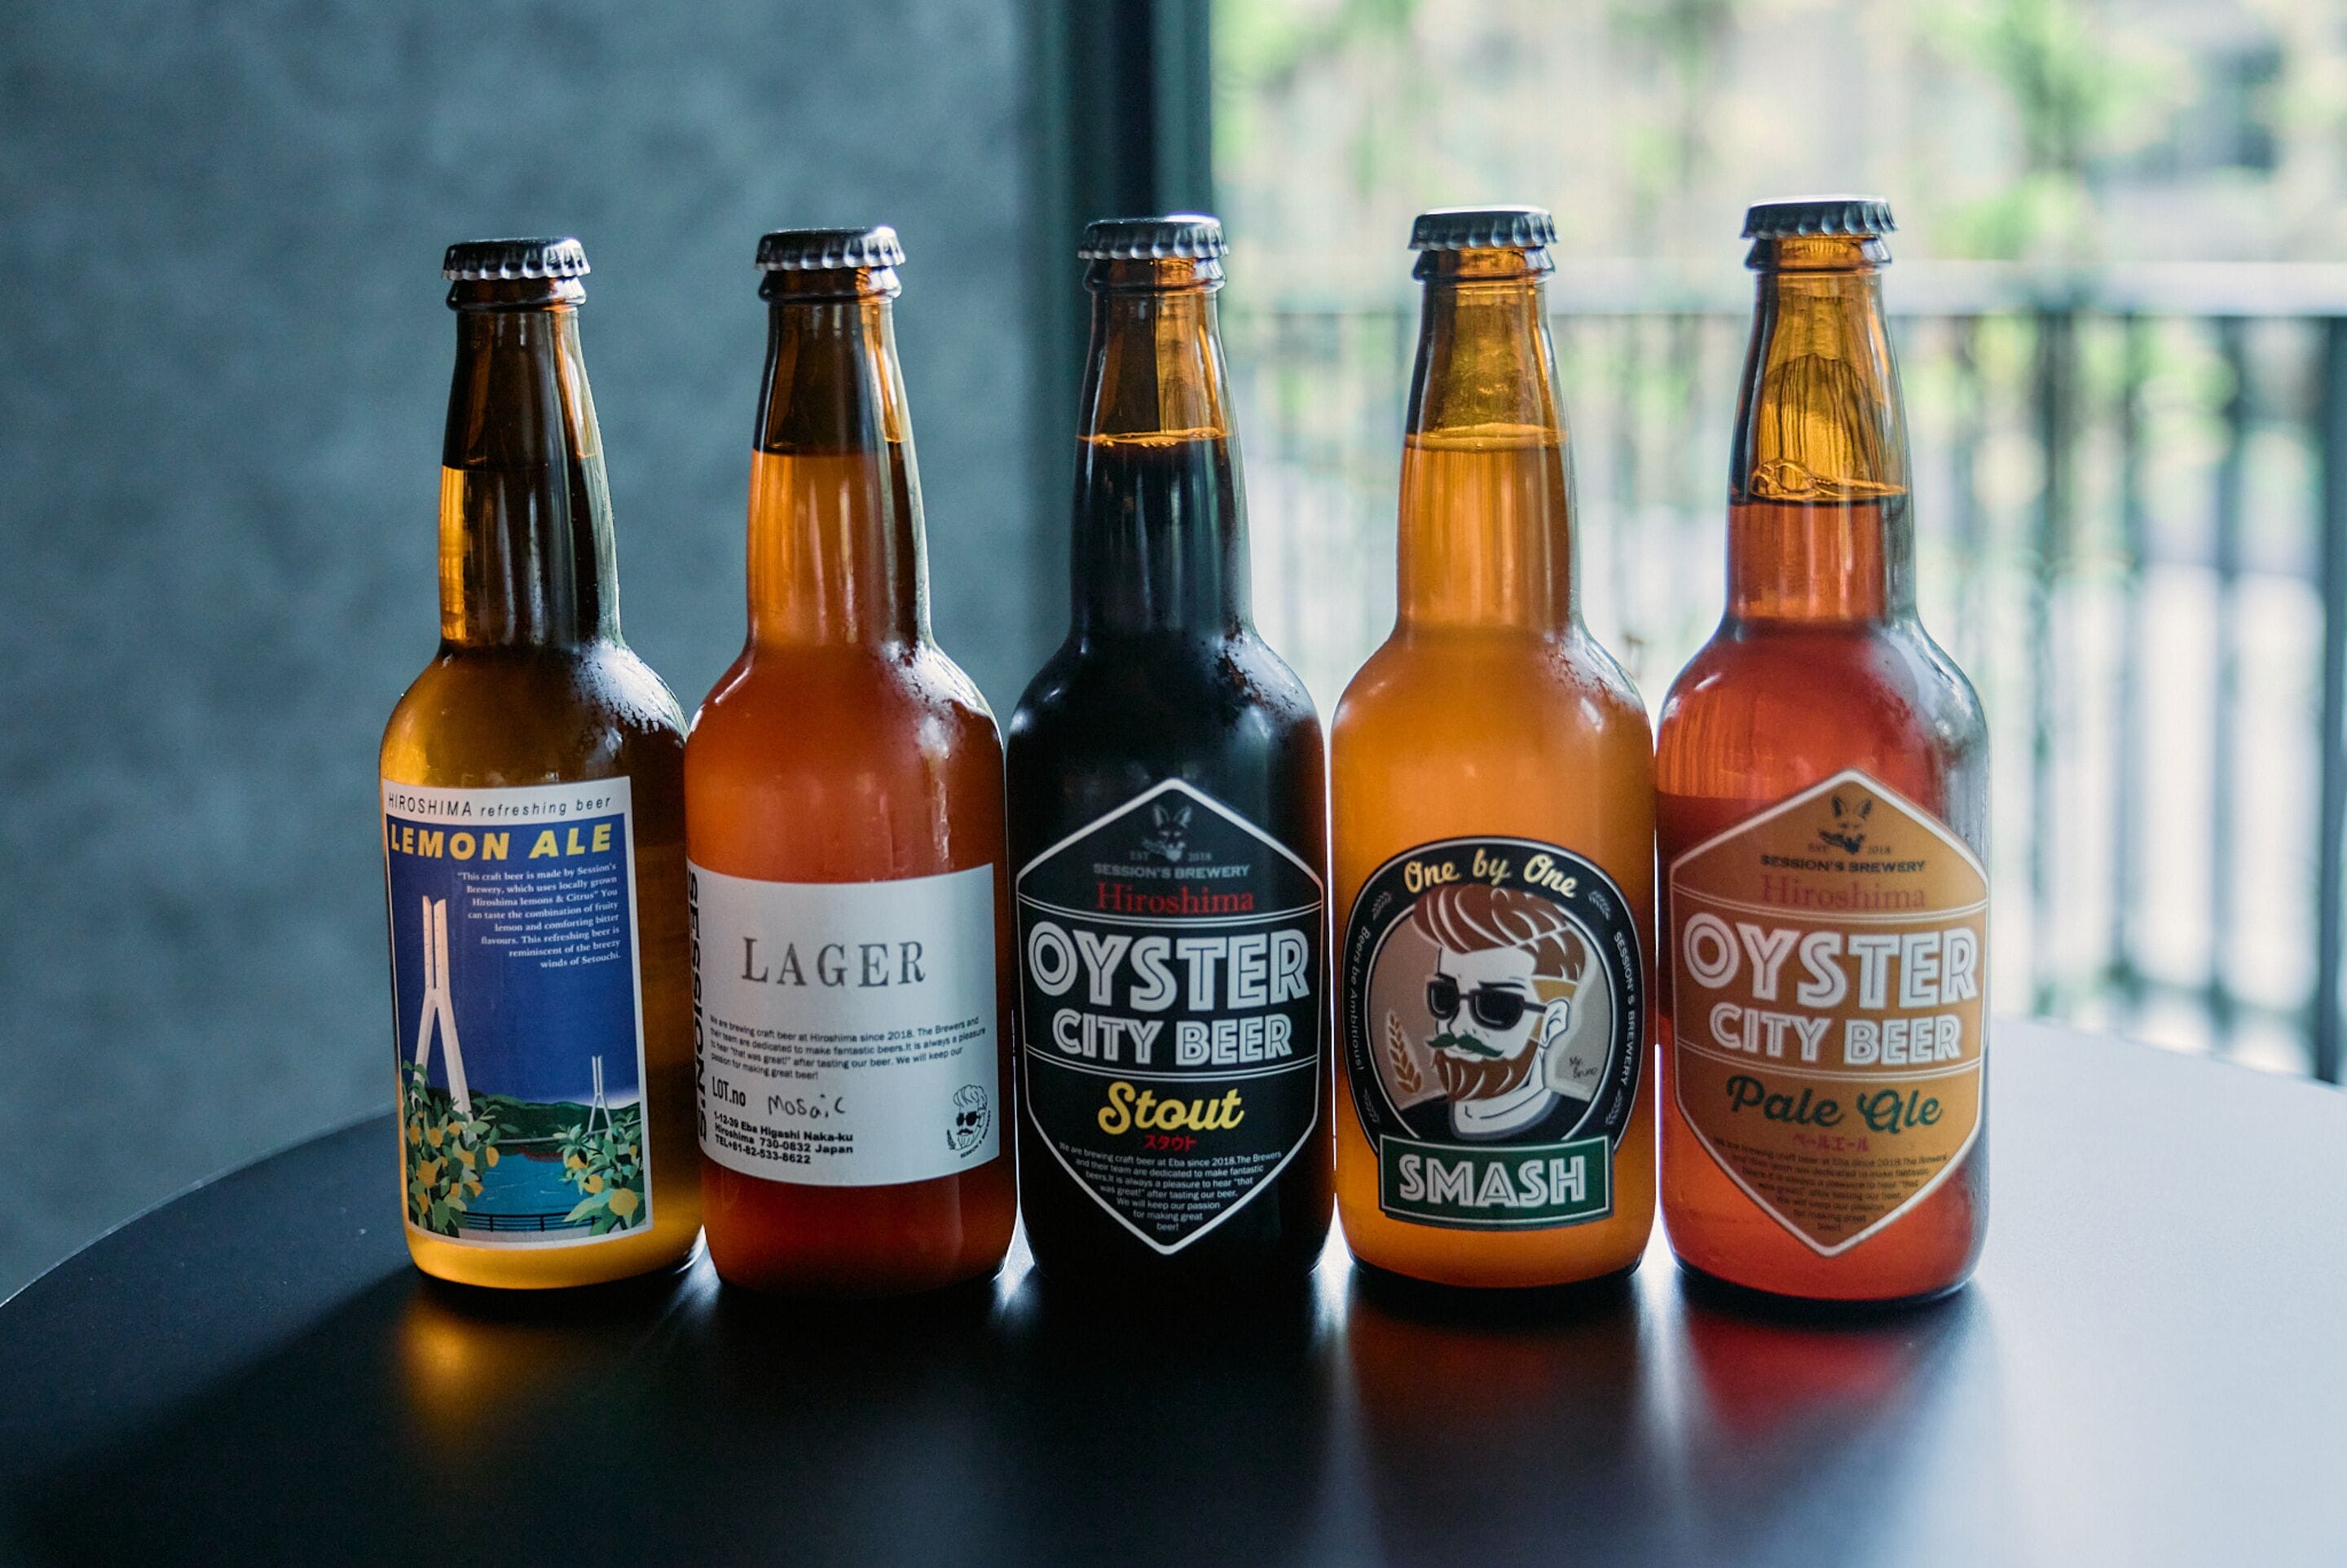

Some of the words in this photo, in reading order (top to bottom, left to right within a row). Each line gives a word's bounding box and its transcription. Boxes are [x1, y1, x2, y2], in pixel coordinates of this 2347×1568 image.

[389, 792, 473, 817] HIROSHIMA
[481, 801, 566, 817] refreshing
[576, 796, 611, 812] beer
[391, 823, 509, 861] LEMON
[529, 823, 612, 859] ALE
[482, 872, 502, 880] craft
[504, 871, 524, 880] beer
[526, 870, 534, 879] is
[537, 870, 561, 879] made
[564, 868, 575, 878] by
[577, 863, 617, 875] Session's
[1094, 863, 1171, 879] SESSION'S
[1175, 864, 1250, 879] BREWERY
[1404, 861, 1461, 894] One
[1473, 848, 1511, 886] by
[1523, 854, 1577, 898] One
[1761, 854, 1844, 871] SESSION'S
[1848, 861, 1925, 873] BREWERY
[467, 885, 505, 895] Brewery,
[506, 884, 535, 894] which
[536, 884, 557, 892] uses
[559, 879, 588, 890] locally
[590, 876, 618, 888] grown
[1762, 874, 1924, 910] Hiroshima
[473, 897, 518, 906] Hiroshima
[521, 896, 553, 905] lemons
[556, 895, 564, 903] &
[601, 889, 618, 897] You
[1098, 882, 1253, 914] Hiroshima
[484, 911, 505, 919] taste
[508, 910, 522, 919] the
[525, 906, 582, 918] combination
[583, 905, 593, 914] of
[595, 901, 619, 911] fruity
[495, 923, 523, 932] lemon
[526, 921, 542, 931] and
[544, 918, 594, 929] comforting
[595, 914, 619, 924] bitter
[521, 935, 542, 944] This
[544, 932, 591, 943] refreshing
[592, 928, 610, 938] beer
[1354, 926, 1370, 963] Beers
[509, 946, 562, 957] reminiscent
[564, 945, 574, 954] of
[575, 943, 591, 952] the
[592, 939, 620, 950] breezy
[540, 958, 568, 968] winds
[570, 956, 580, 966] of
[742, 937, 926, 988] LAGER
[1028, 921, 1310, 1012] OYSTER
[1682, 912, 1979, 1010] OYSTER
[1350, 966, 1361, 985] be
[757, 1028, 775, 1039] craft
[777, 1031, 796, 1041] beer
[810, 1033, 857, 1042] Hiroshima
[860, 1033, 885, 1042] since
[918, 1028, 932, 1036] The
[936, 1021, 965, 1034] Brewers
[967, 1015, 979, 1027] and
[1052, 1008, 1163, 1064] CITY
[1175, 1013, 1292, 1067] BEER
[1350, 987, 1364, 1071] Ambitious!
[1709, 1002, 1831, 1061] CITY
[1843, 1013, 1962, 1066] BEER
[752, 1041, 792, 1053] dedicated
[794, 1046, 804, 1054] to
[806, 1046, 831, 1055] make
[834, 1046, 875, 1055] fantastic
[914, 1042, 921, 1050] is
[923, 1037, 950, 1048] always
[959, 1027, 986, 1043] pleasure
[1620, 1010, 1635, 1086] BREWERY
[794, 1058, 814, 1067] after
[852, 1059, 867, 1068] our
[896, 1056, 910, 1064] We
[913, 1052, 927, 1062] will
[929, 1050, 949, 1059] keep
[951, 1046, 963, 1056] our
[771, 1068, 793, 1078] great
[711, 1076, 746, 1108] LOT.no
[1098, 1081, 1245, 1134] Stout
[1726, 1075, 1844, 1127] Pale
[1856, 1088, 1944, 1134] Ale
[714, 1111, 739, 1129] 1-12-39
[742, 1121, 757, 1134] Eba
[760, 1125, 800, 1139] Higashi
[804, 1131, 853, 1142] Naka-ku
[715, 1122, 755, 1144] Hiroshima
[760, 1137, 811, 1152] 730-0832
[815, 1143, 854, 1155] Japan
[1143, 1134, 1197, 1151] スタウト
[1076, 1158, 1090, 1167] and
[1090, 1161, 1108, 1170] their
[1110, 1165, 1132, 1174] team
[1149, 1169, 1191, 1178] dedicated
[1194, 1169, 1202, 1178] to
[1204, 1169, 1228, 1178] make
[1230, 1165, 1264, 1175] fantastic
[1084, 1148, 1114, 1163] brewing
[1115, 1154, 1134, 1164] craft
[1136, 1156, 1155, 1165] beer
[1157, 1158, 1166, 1166] at
[1169, 1157, 1185, 1166] Eba
[1187, 1158, 1210, 1166] since
[1253, 1151, 1282, 1162] Brewers
[1163, 1179, 1200, 1188] pleasure
[1213, 1178, 1231, 1187] hear
[1398, 1153, 1586, 1207] SMASH
[1132, 1199, 1146, 1208] will
[1147, 1200, 1169, 1210] keep
[1187, 1201, 1221, 1211] passion
[1147, 1190, 1167, 1199] after
[1169, 1191, 1200, 1200] tasting
[1217, 1190, 1238, 1199] beer.
[1133, 1209, 1144, 1218] for
[1147, 1211, 1179, 1222] making
[1180, 1213, 1203, 1222] great
[1156, 1222, 1179, 1231] beer!
